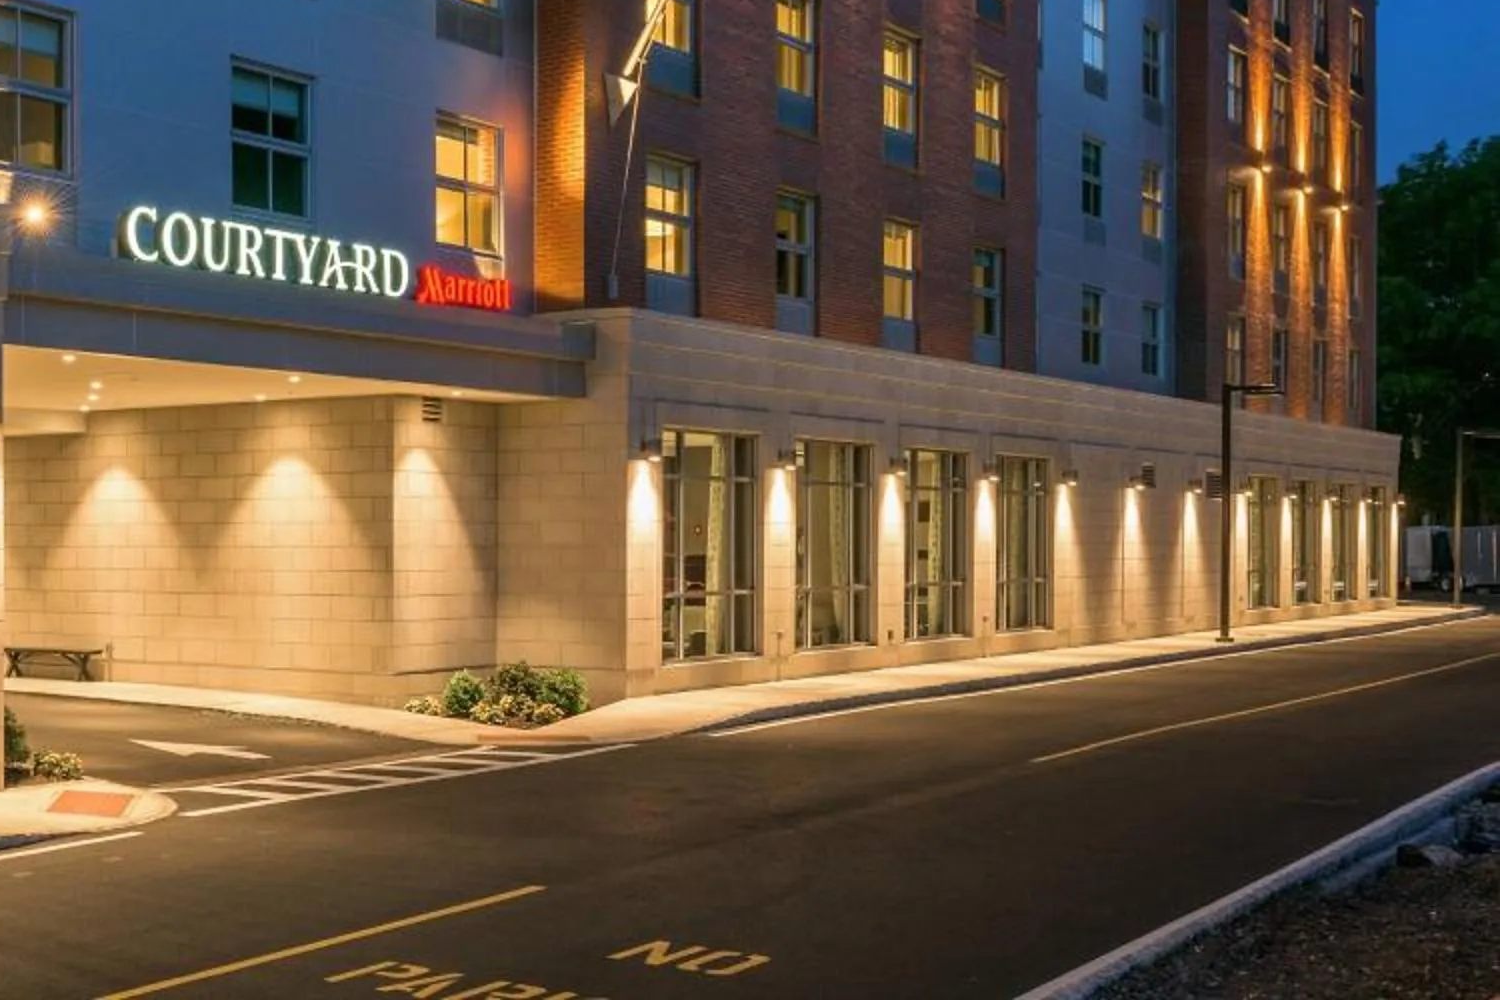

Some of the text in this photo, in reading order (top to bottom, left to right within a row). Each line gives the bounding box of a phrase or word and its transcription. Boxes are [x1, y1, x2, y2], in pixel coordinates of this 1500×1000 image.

[126, 206, 512, 309] COURTYARD Marriott
[606, 940, 772, 976] NO
[323, 960, 579, 1000] PAR
